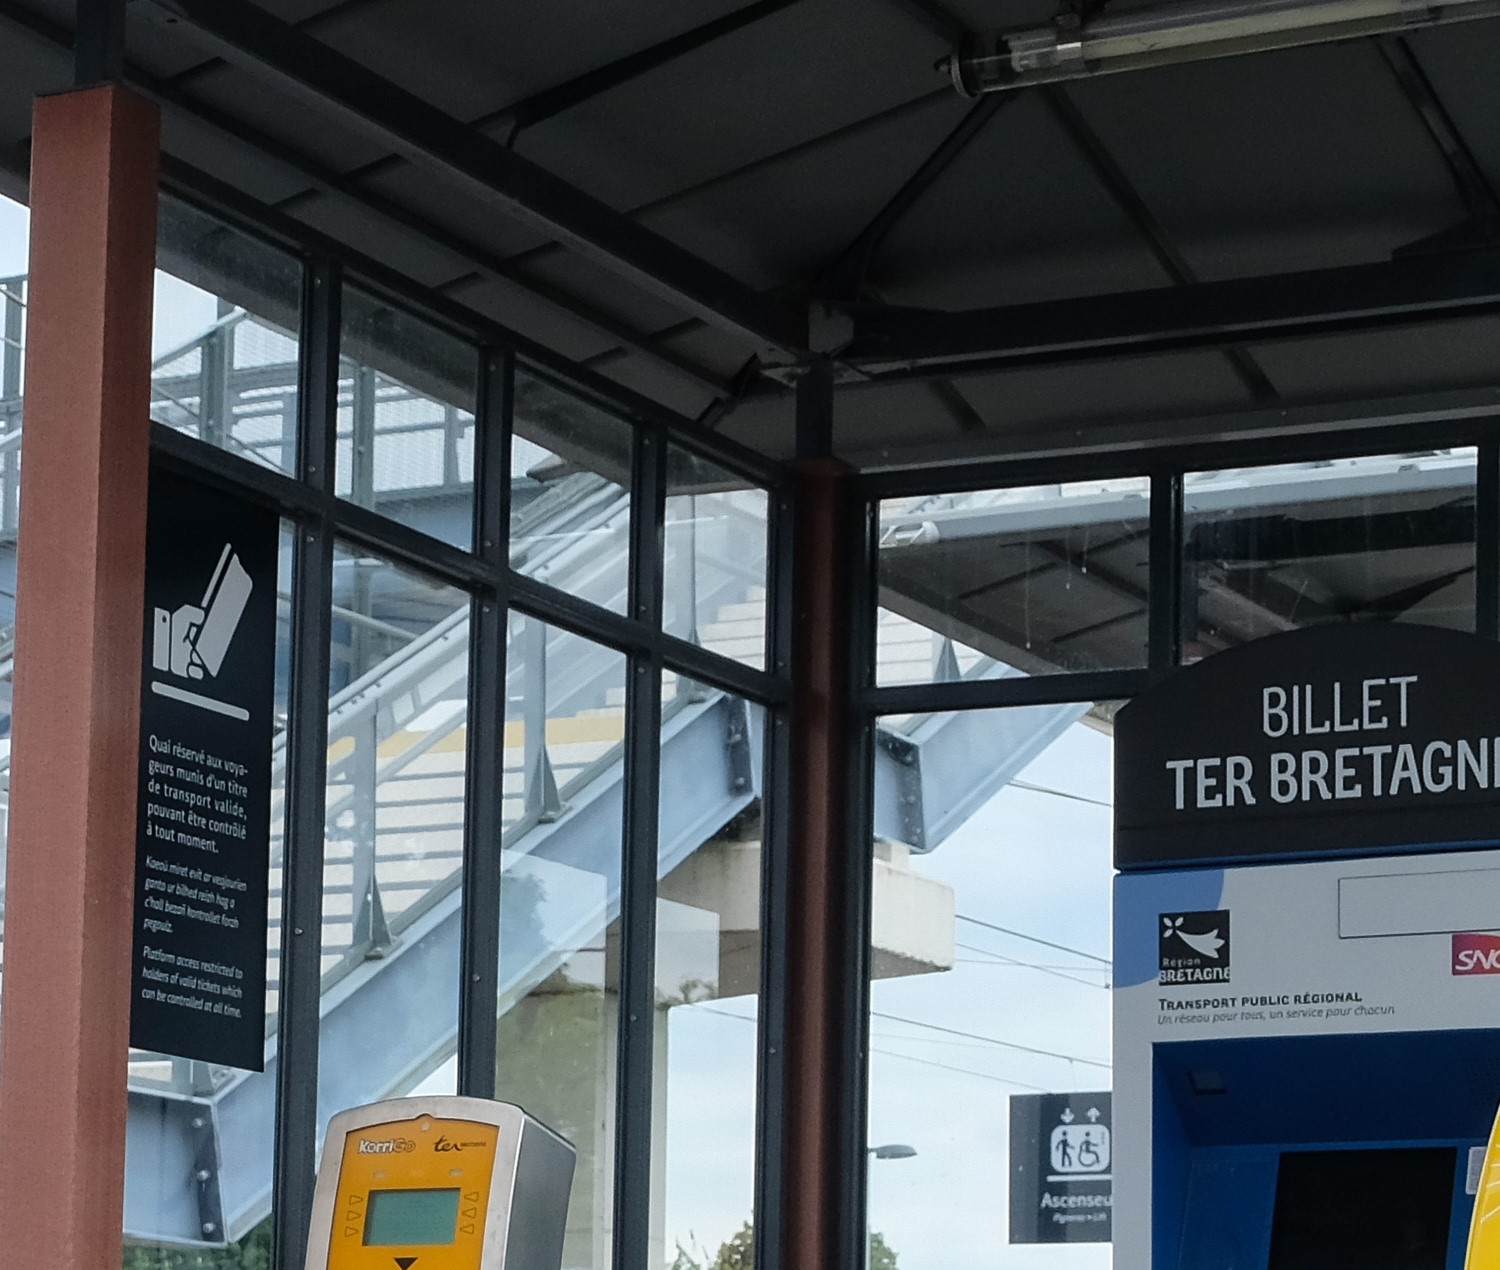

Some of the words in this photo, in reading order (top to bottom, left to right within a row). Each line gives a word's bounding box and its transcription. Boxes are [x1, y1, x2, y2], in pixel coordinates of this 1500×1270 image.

[1262, 676, 1418, 738] BILLET
[150, 734, 171, 754] Quai
[173, 742, 205, 764] réservé
[207, 754, 222, 768] aux
[224, 760, 248, 778] voya-
[149, 760, 174, 777] geurs
[176, 767, 204, 785] munis
[206, 773, 226, 790] d'un
[228, 779, 248, 798] titre
[1165, 755, 1256, 810] TER
[148, 778, 161, 794] de
[164, 783, 211, 808] transport
[214, 798, 247, 821] valide,
[147, 802, 185, 823] pouvant
[188, 811, 207, 829] être
[208, 818, 247, 840] contrôlé
[147, 821, 152, 836] à
[155, 825, 175, 842] tout
[177, 832, 219, 853] moment.
[1159, 966, 1230, 983] BRETAGNE
[1240, 994, 1289, 1006] PUBLIC
[358, 1137, 416, 1154] KorriGo
[1040, 1192, 1112, 1208] Ascenseu
